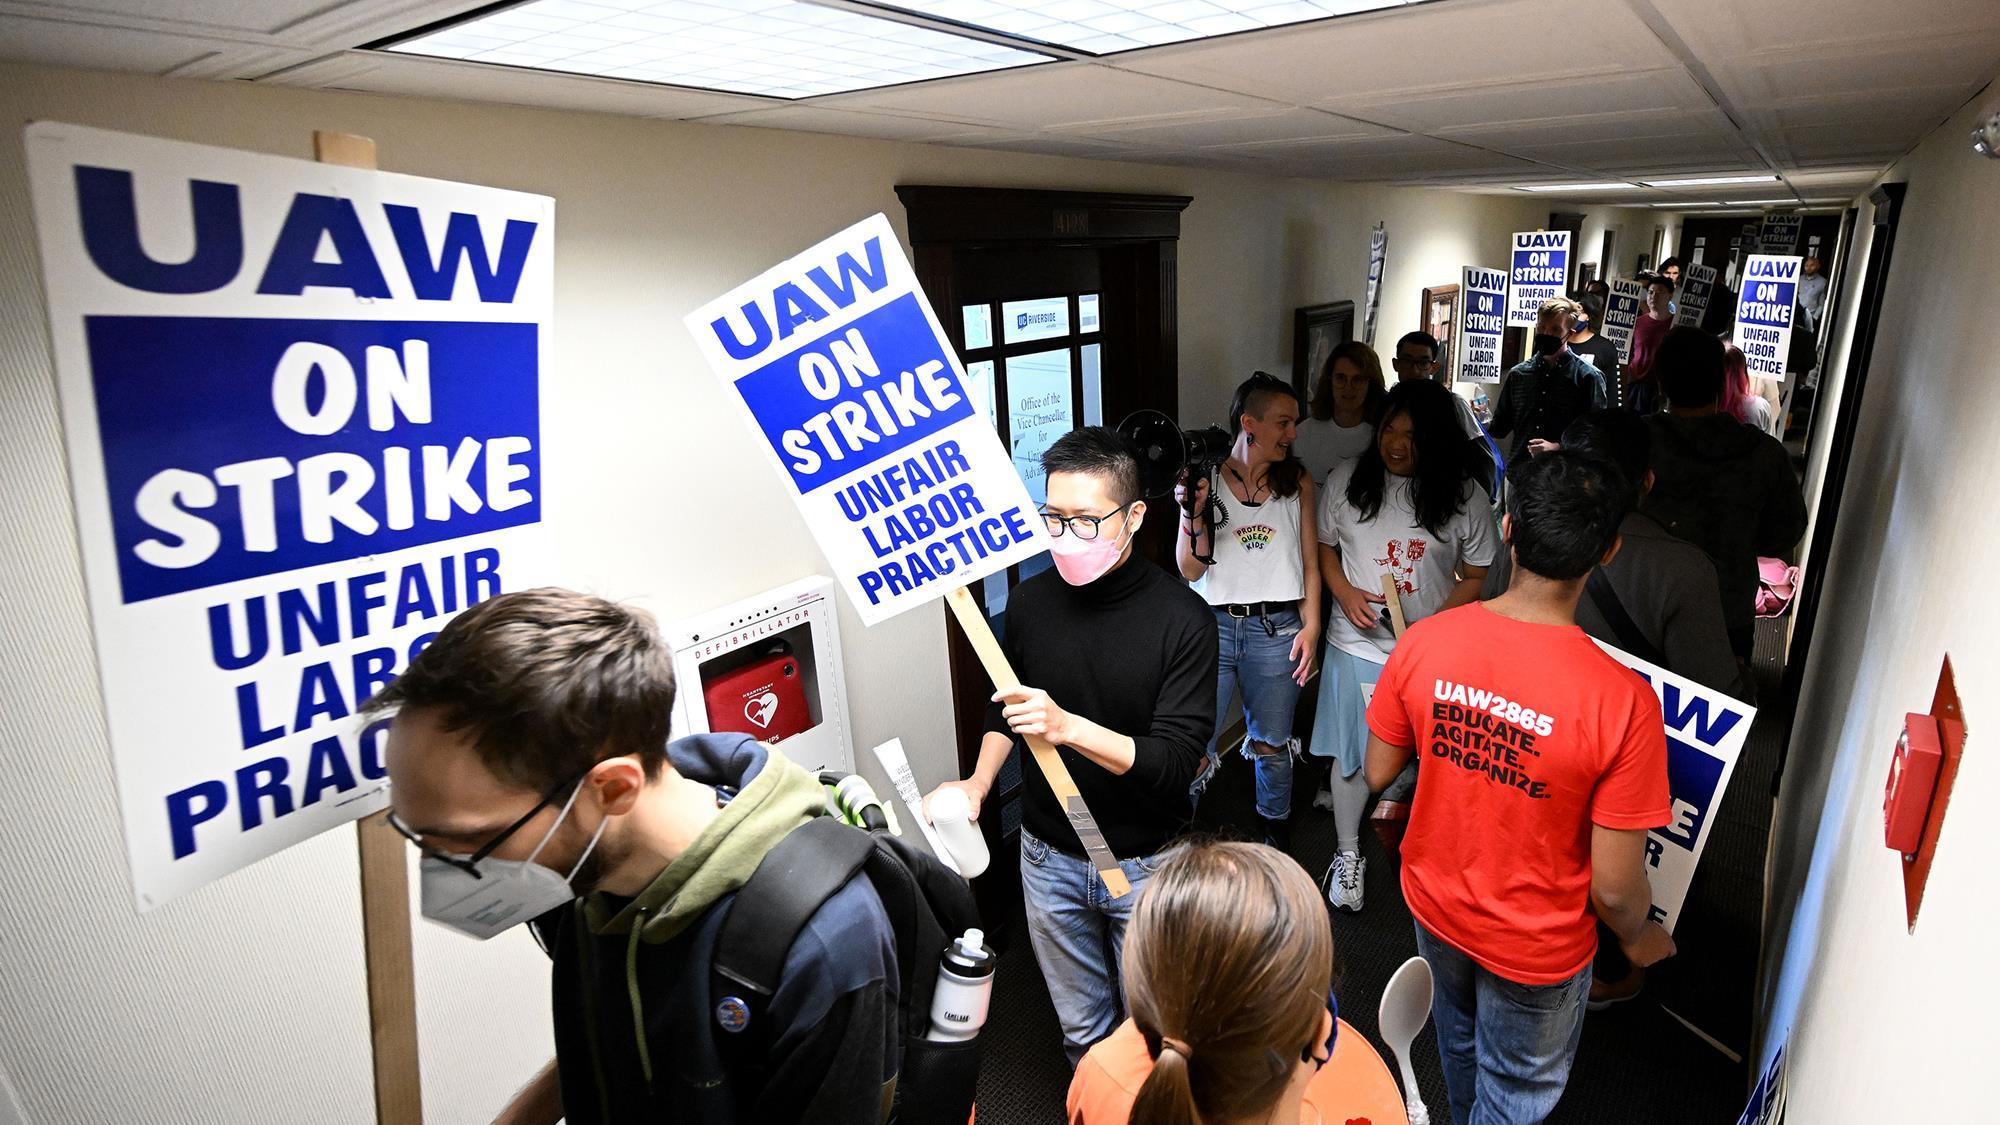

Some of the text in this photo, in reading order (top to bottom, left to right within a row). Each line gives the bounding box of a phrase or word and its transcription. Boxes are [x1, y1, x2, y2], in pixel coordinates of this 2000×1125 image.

[1767, 216, 1800, 224] UAW
[73, 164, 538, 303] UAW
[1517, 234, 1566, 247] UAW
[1762, 233, 1795, 243] STRIKE
[1529, 252, 1549, 266] ON
[1513, 267, 1563, 282] STRIKE
[1689, 266, 1714, 281] UAW
[1749, 261, 1797, 278] UAW
[1467, 271, 1505, 291] UAW
[1613, 280, 1641, 296] UAW
[1692, 281, 1702, 293] ON
[710, 235, 888, 360] UAW
[1518, 288, 1555, 298] UNFAIR
[1681, 292, 1706, 308] STRIKE
[1756, 283, 1778, 302] ON
[1478, 295, 1492, 312] ON
[1618, 297, 1630, 310] ON
[1740, 301, 1790, 323] STRIKE
[1028, 312, 1056, 325] RIVERSIDE
[1466, 313, 1502, 331] STRIKE
[1606, 308, 1636, 325] STRIKE
[1608, 328, 1628, 339] UNFAIR
[1743, 328, 1780, 343] UNFAIR
[1469, 336, 1496, 349] UNFAIR
[1743, 342, 1776, 358] LABOR
[799, 328, 880, 401] ON
[1469, 350, 1494, 363] LABOR
[1462, 364, 1499, 378] PRACTICE
[1746, 359, 1782, 375] ACTICE
[272, 339, 432, 435] ON
[1020, 392, 1061, 411] Office of the
[781, 359, 961, 475] STRIKE
[1017, 409, 1066, 430] Vice Chancellor
[1038, 430, 1048, 443] for
[834, 440, 971, 522] UNFAIR
[133, 436, 534, 570] STRIKE
[862, 482, 985, 559] LABOR
[1236, 525, 1273, 537] PROTECT
[1241, 534, 1268, 543] QUEER
[1246, 542, 1264, 550] KIDS
[857, 506, 1034, 606] PRACTICE
[207, 547, 501, 671] UNFAIR
[695, 609, 809, 659] DEFIBRILLATOR
[235, 631, 446, 750] LAB
[742, 682, 774, 698] HEARTSTART
[1434, 679, 1554, 737] UAW2865
[1433, 702, 1540, 757] EDUCATE.
[1432, 723, 1525, 769] AGITATE.
[1432, 742, 1552, 799] ORGANIZE.
[165, 719, 392, 860] PRAC
